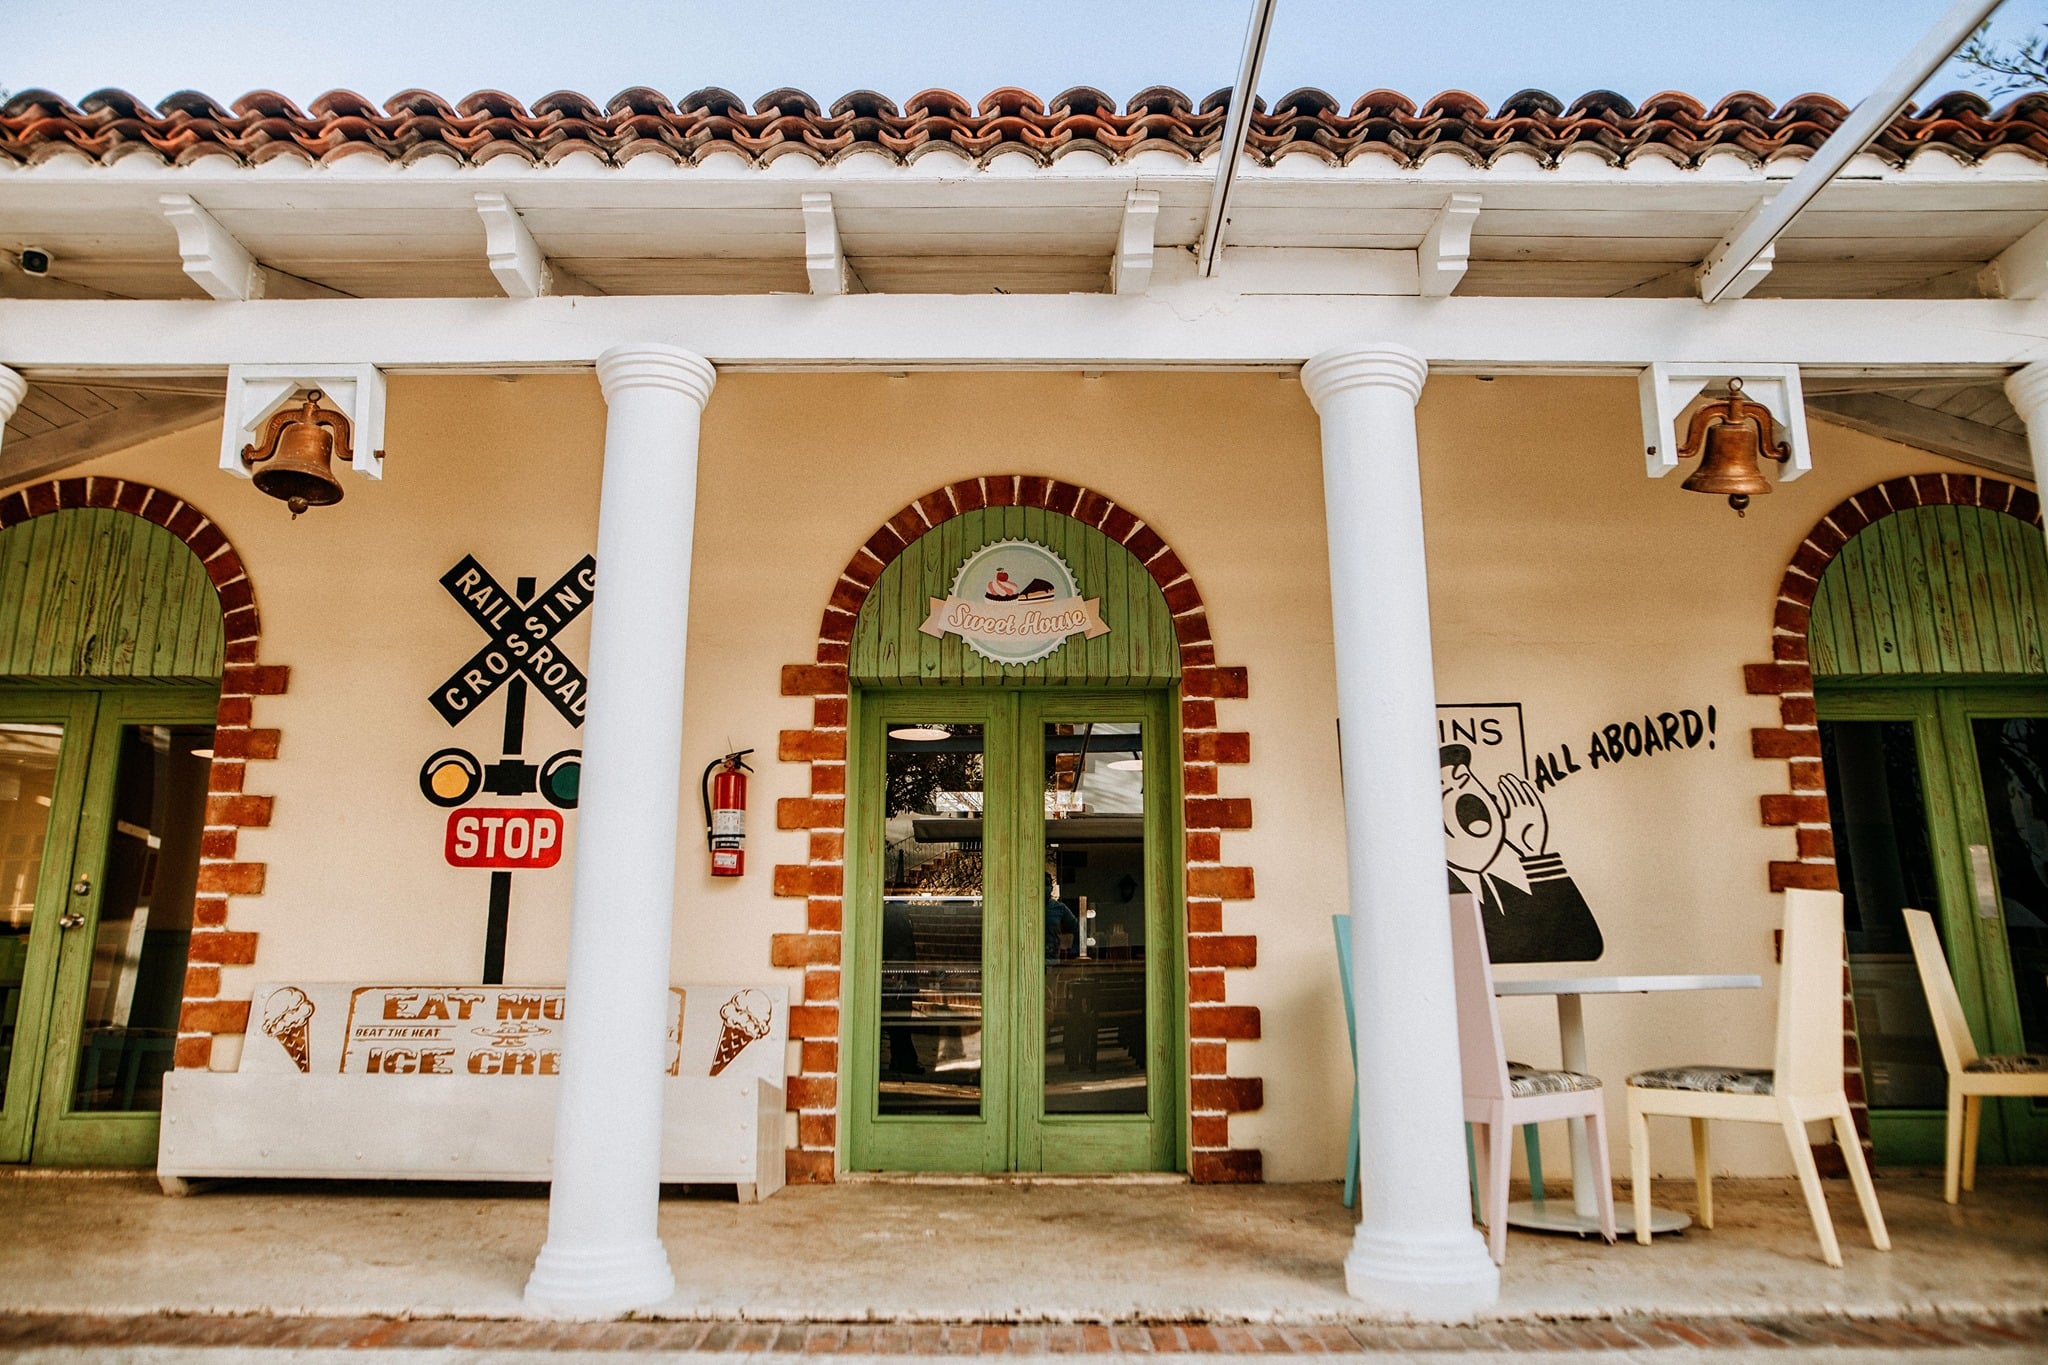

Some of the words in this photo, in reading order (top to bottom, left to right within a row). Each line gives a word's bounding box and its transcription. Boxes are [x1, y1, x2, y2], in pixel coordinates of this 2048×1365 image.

[947, 603, 1016, 635] Sweet
[1018, 610, 1086, 635] House
[446, 568, 596, 711] CROSSING
[455, 568, 512, 631] RAIL
[527, 648, 587, 718] ROAD
[1438, 717, 1503, 746] INS
[1534, 743, 1581, 793] ALL
[1587, 704, 1718, 770] ABOARD!
[455, 816, 556, 859] STOP
[383, 992, 486, 1020] EAT
[355, 1028, 386, 1037] BEAT
[387, 1028, 408, 1037] THE
[411, 1028, 441, 1037] HEAT
[366, 1047, 456, 1074] ICE
[467, 1047, 561, 1075] CRE
